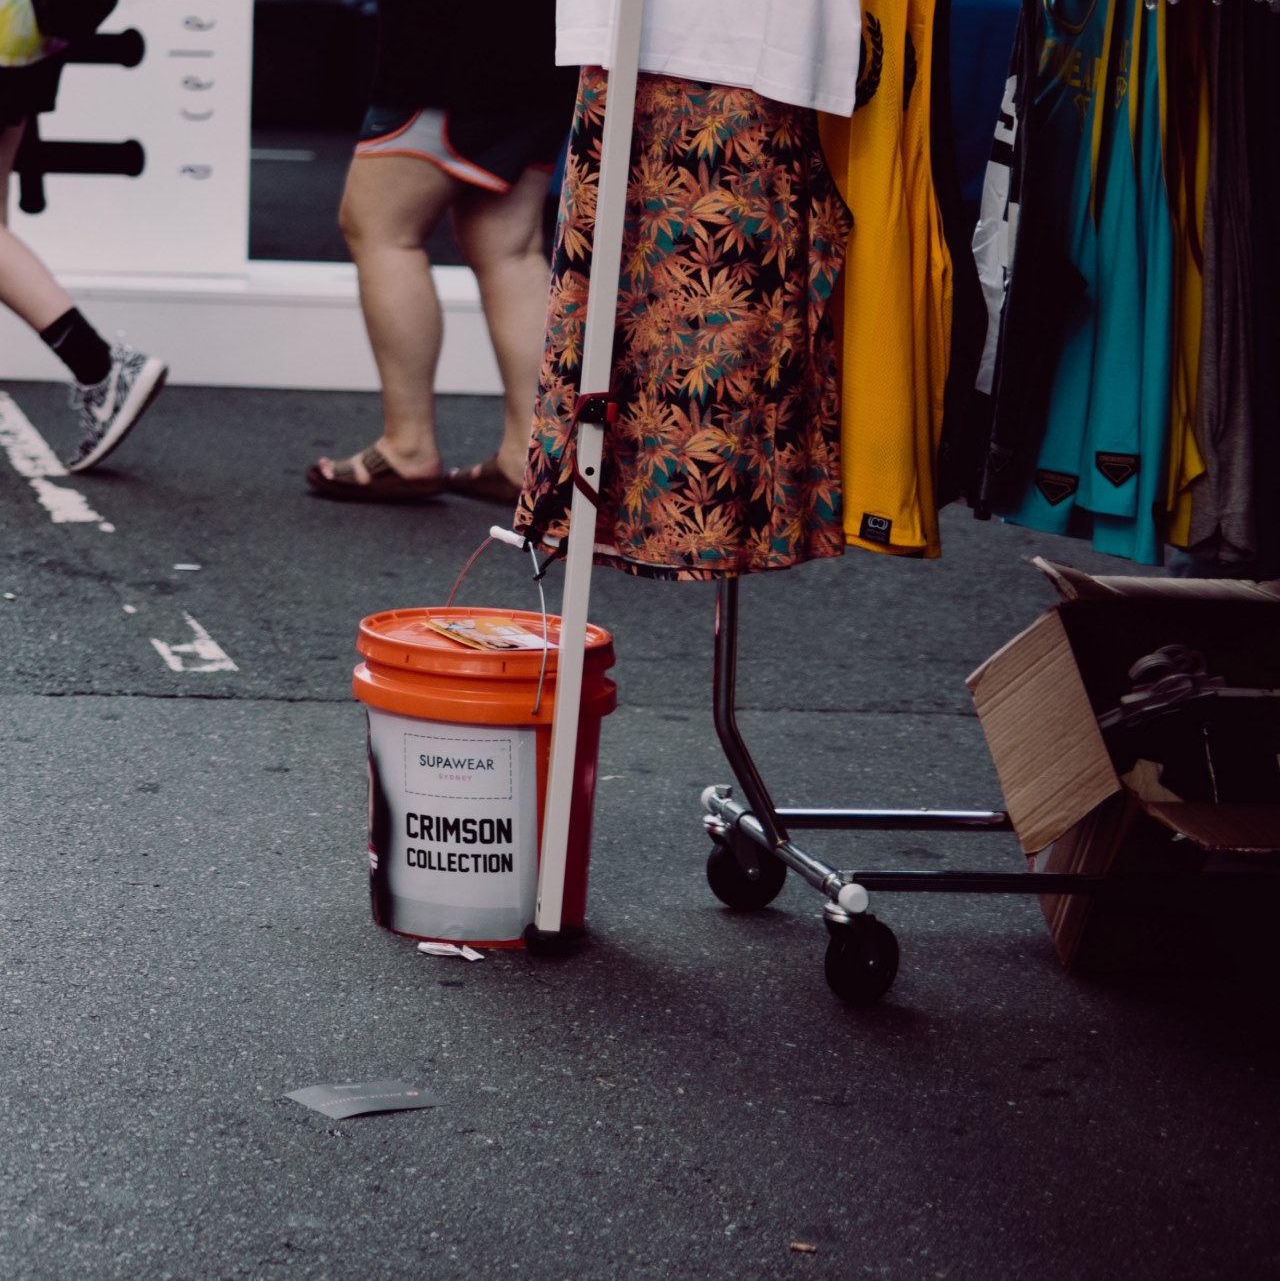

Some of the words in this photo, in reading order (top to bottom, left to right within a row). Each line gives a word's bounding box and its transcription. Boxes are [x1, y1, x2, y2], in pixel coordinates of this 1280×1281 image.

[419, 754, 495, 771] SUPAWEAR
[438, 774, 473, 782] SYDNEY
[406, 812, 513, 845] CRIMSON
[406, 847, 514, 874] COLLECTION
